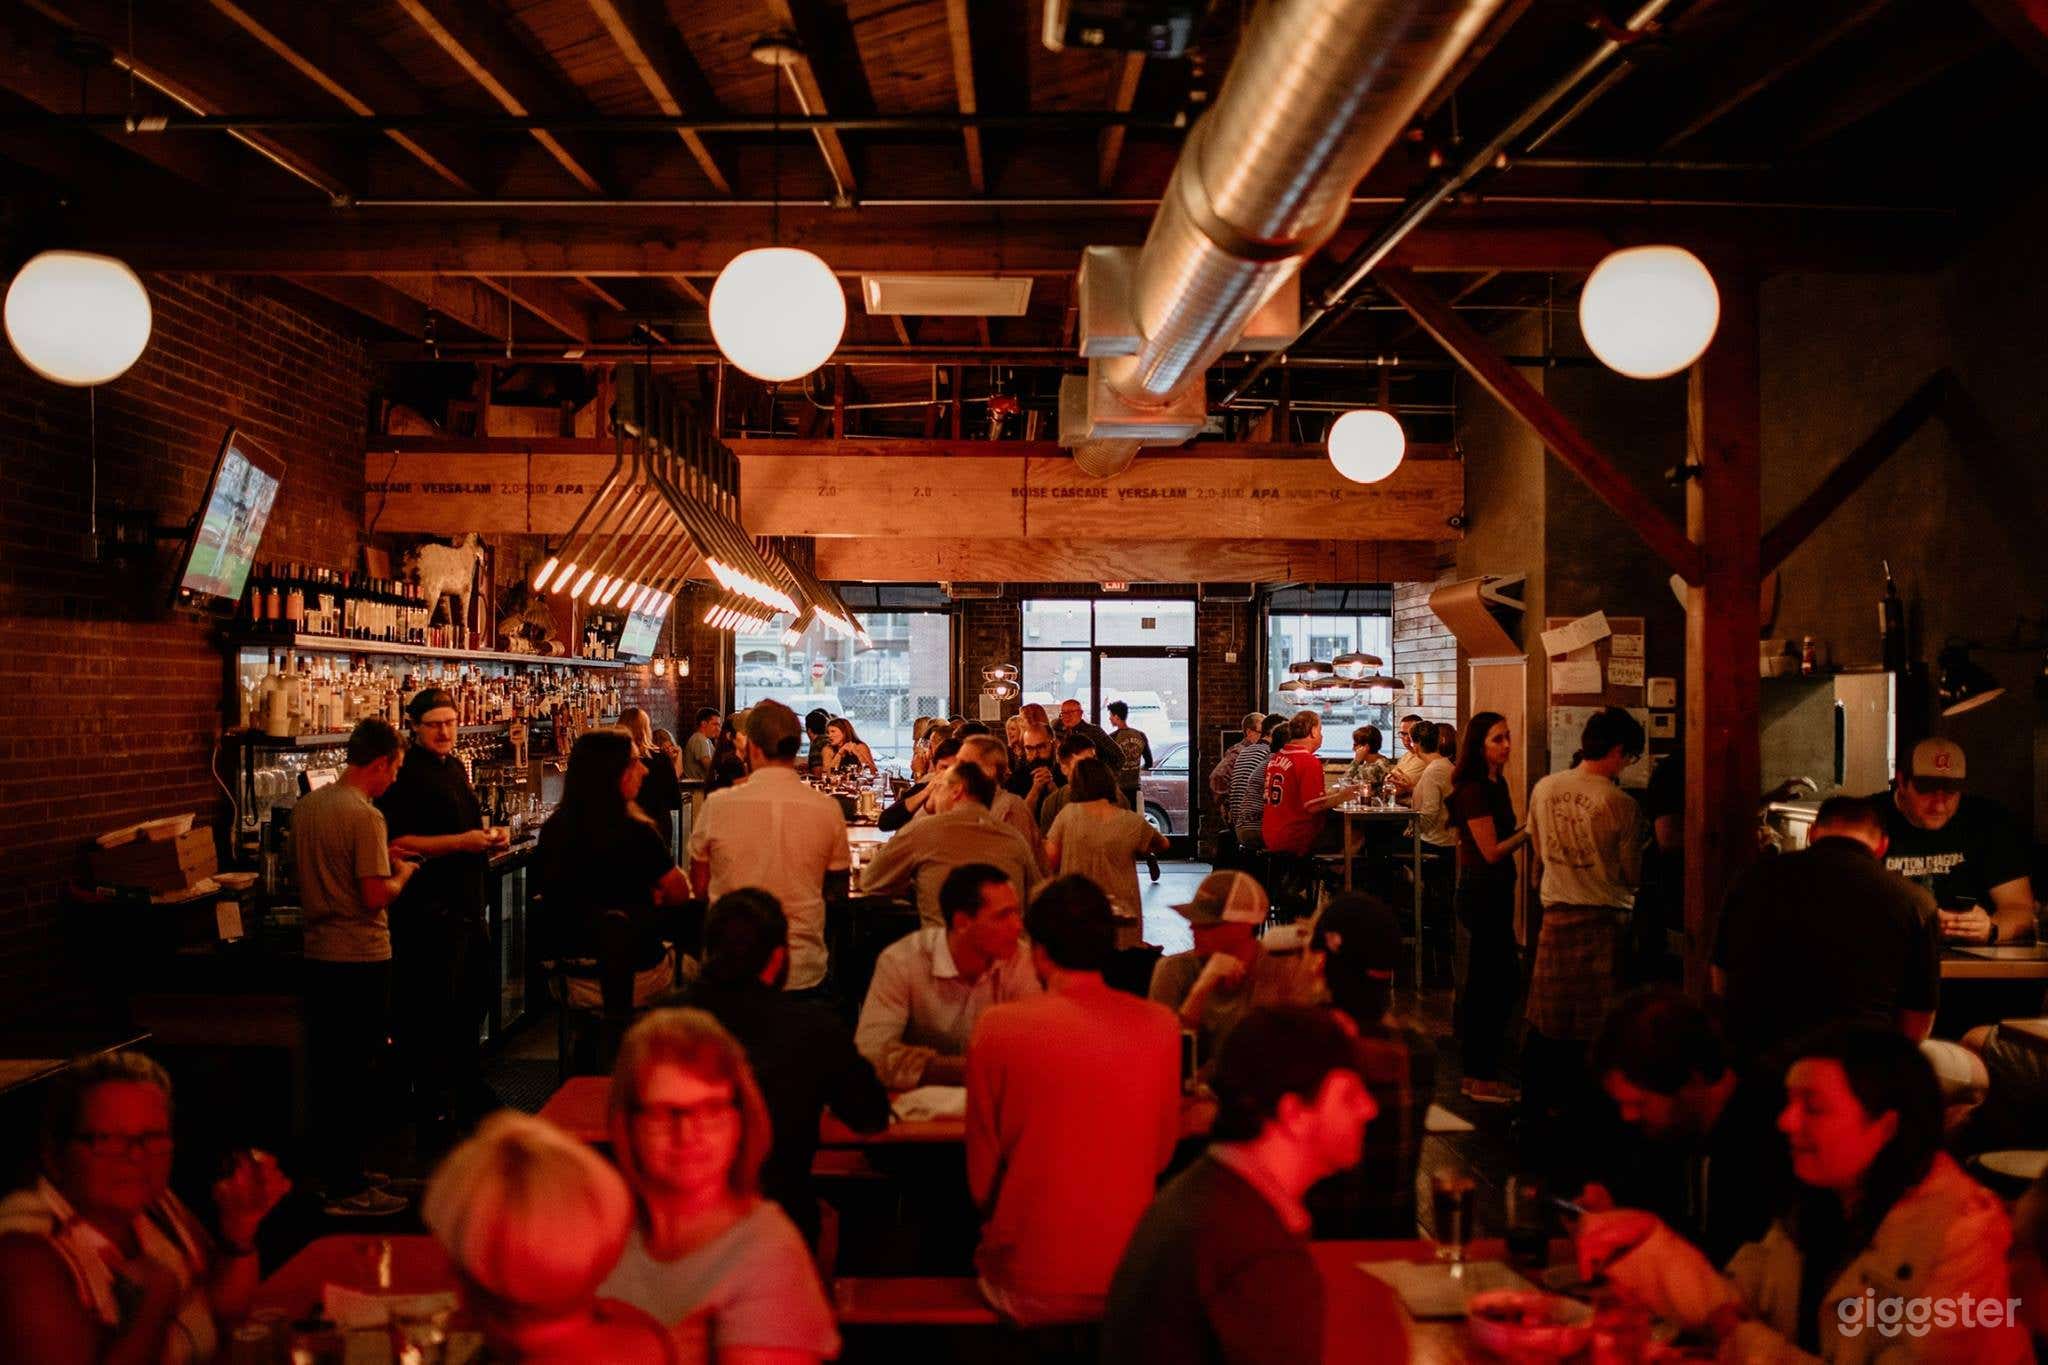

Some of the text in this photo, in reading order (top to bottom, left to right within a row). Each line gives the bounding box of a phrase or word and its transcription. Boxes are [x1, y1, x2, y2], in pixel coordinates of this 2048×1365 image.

[422, 482, 491, 494] VERSA-LAM
[555, 483, 583, 494] APA
[818, 486, 836, 496] 2.0
[913, 486, 931, 496] 2.0
[1011, 487, 1047, 498] BOISE
[1051, 487, 1108, 498] CASCADE
[1117, 487, 1187, 498] VERSA-LAM
[1251, 488, 1280, 499] APA
